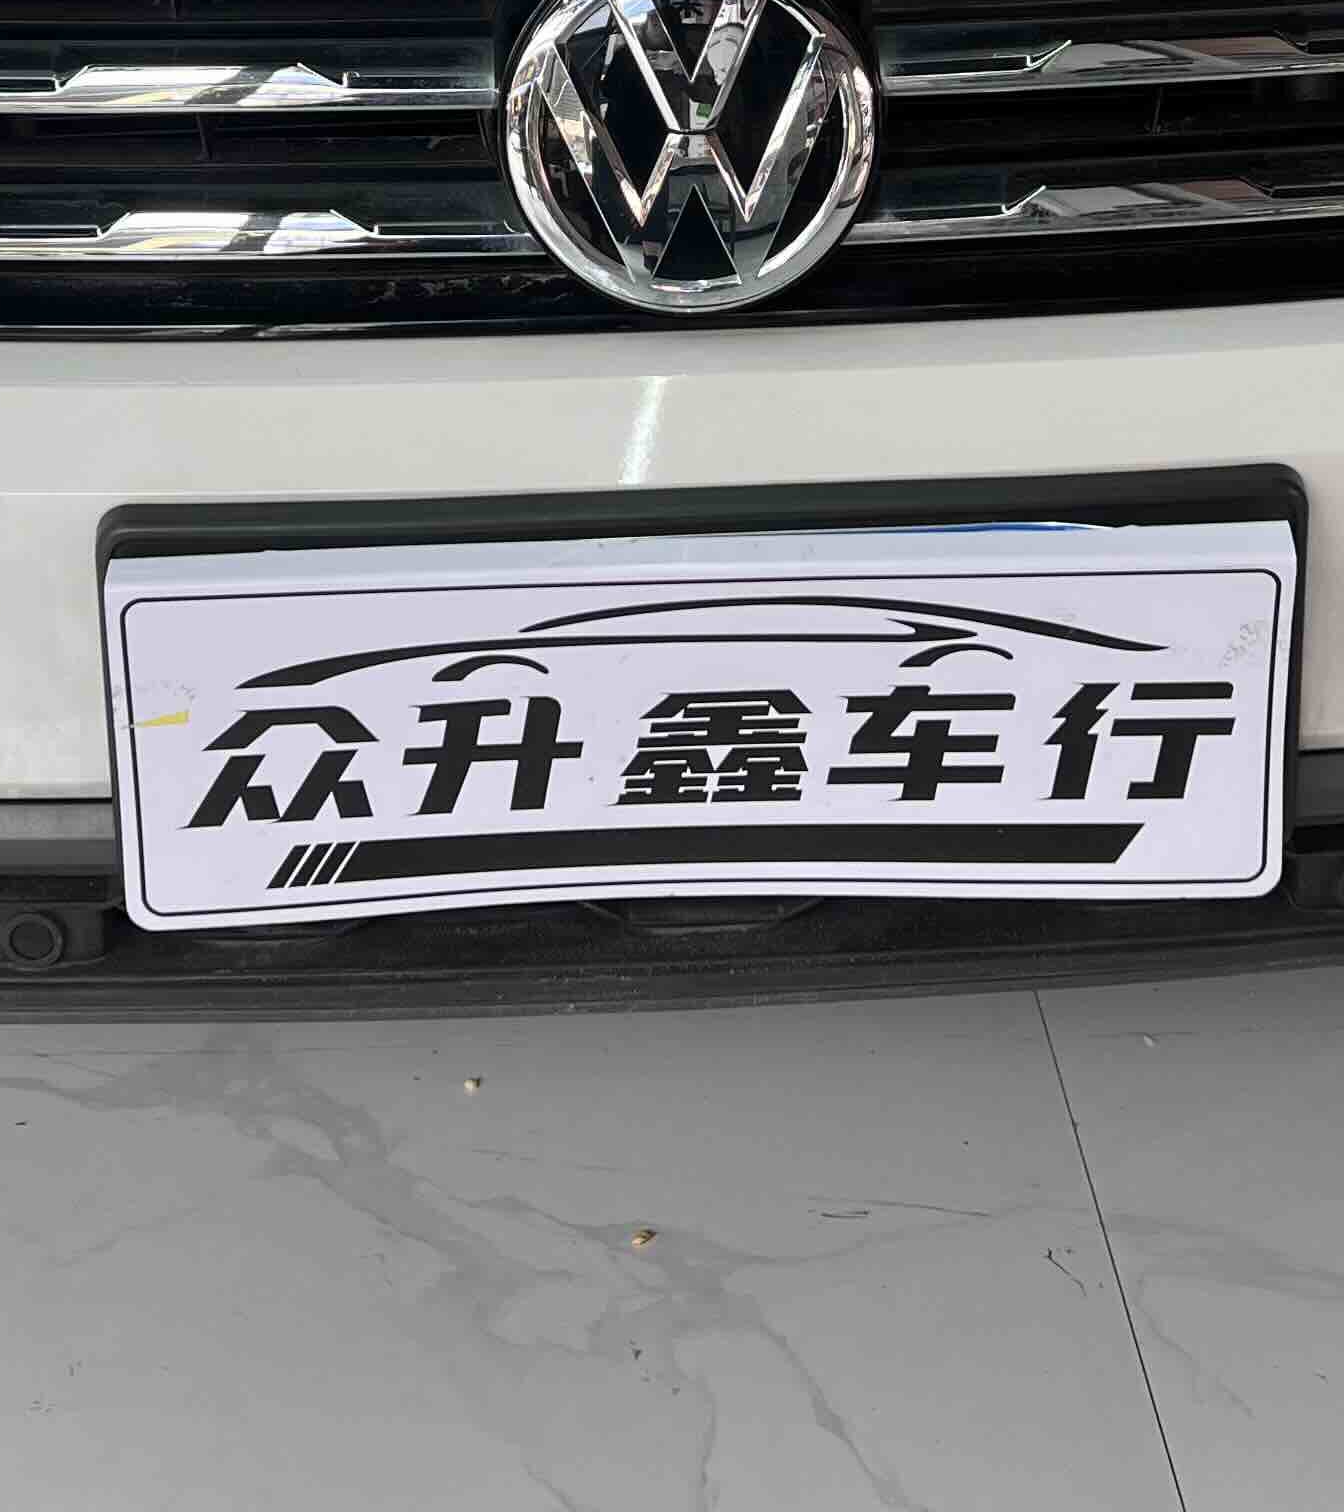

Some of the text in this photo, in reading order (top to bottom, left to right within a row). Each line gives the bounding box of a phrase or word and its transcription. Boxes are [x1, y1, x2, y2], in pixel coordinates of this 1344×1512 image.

[177, 680, 1239, 830] 众升鑫车行
